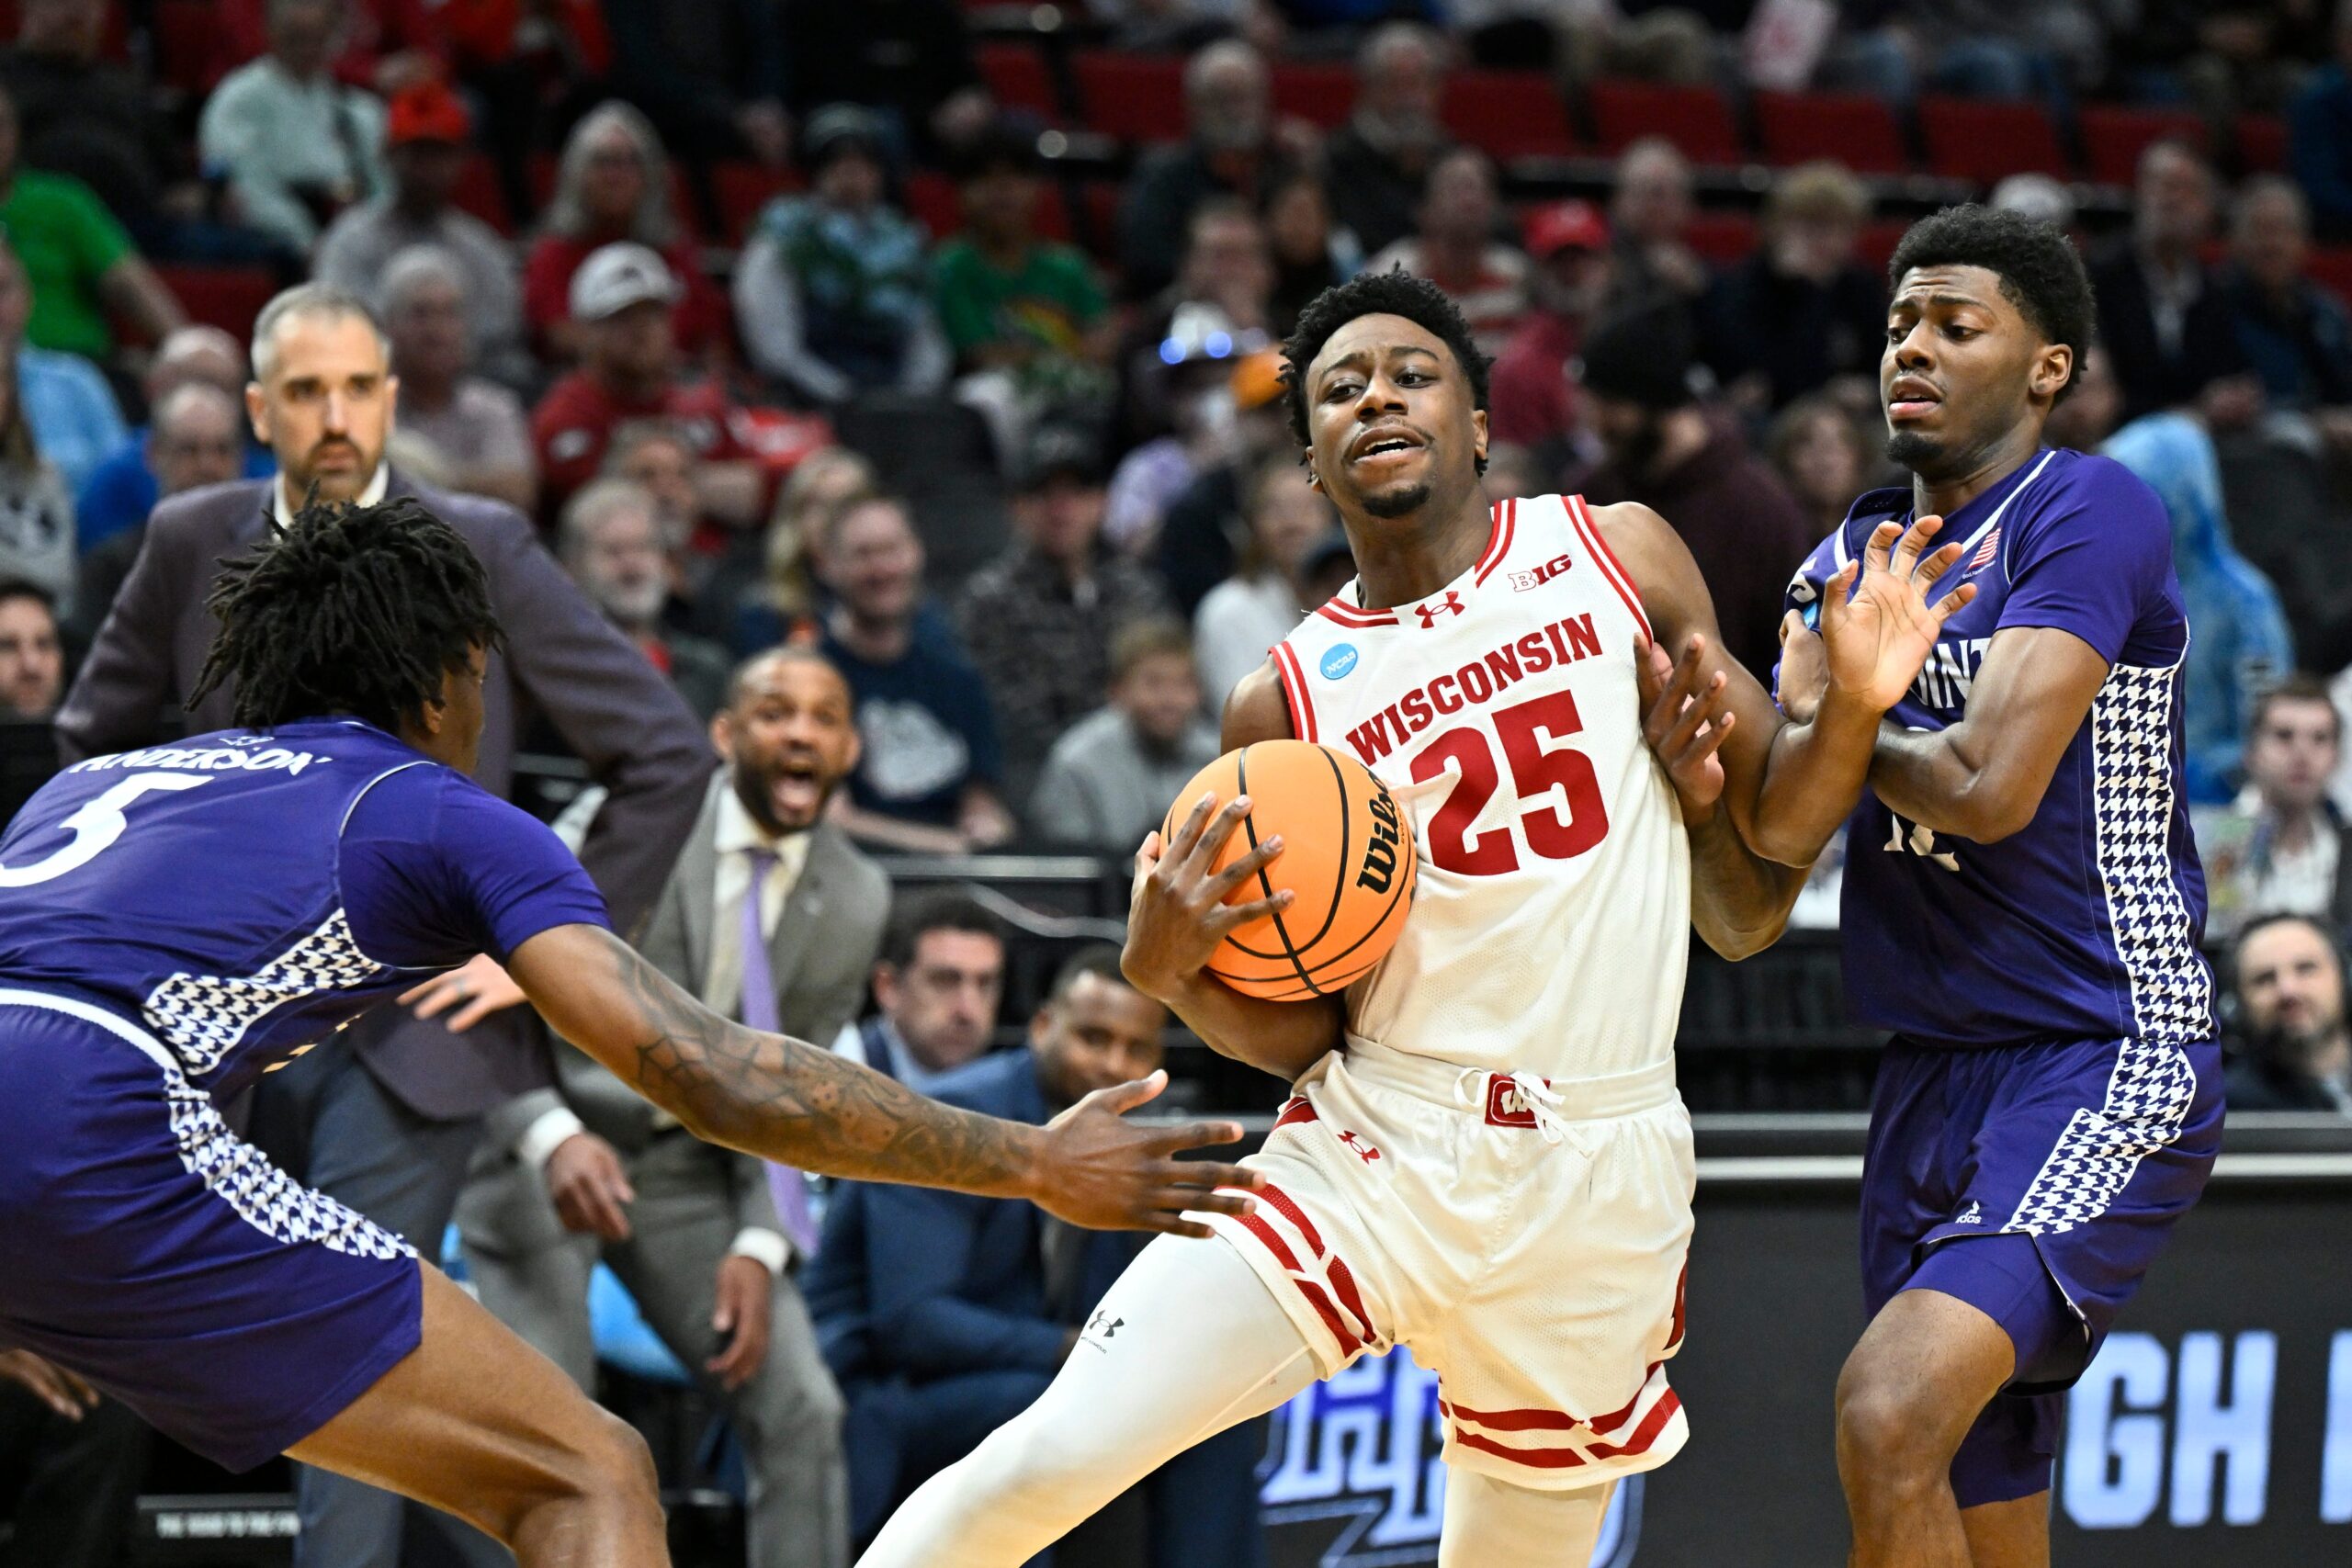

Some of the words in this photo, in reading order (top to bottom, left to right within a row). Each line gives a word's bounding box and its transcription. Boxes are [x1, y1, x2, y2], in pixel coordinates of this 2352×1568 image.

[1326, 651, 1356, 674] NCAA
[1345, 613, 1603, 766] WISCONSIN
[69, 747, 333, 776] ANDERSON
[1409, 689, 1610, 876] 25
